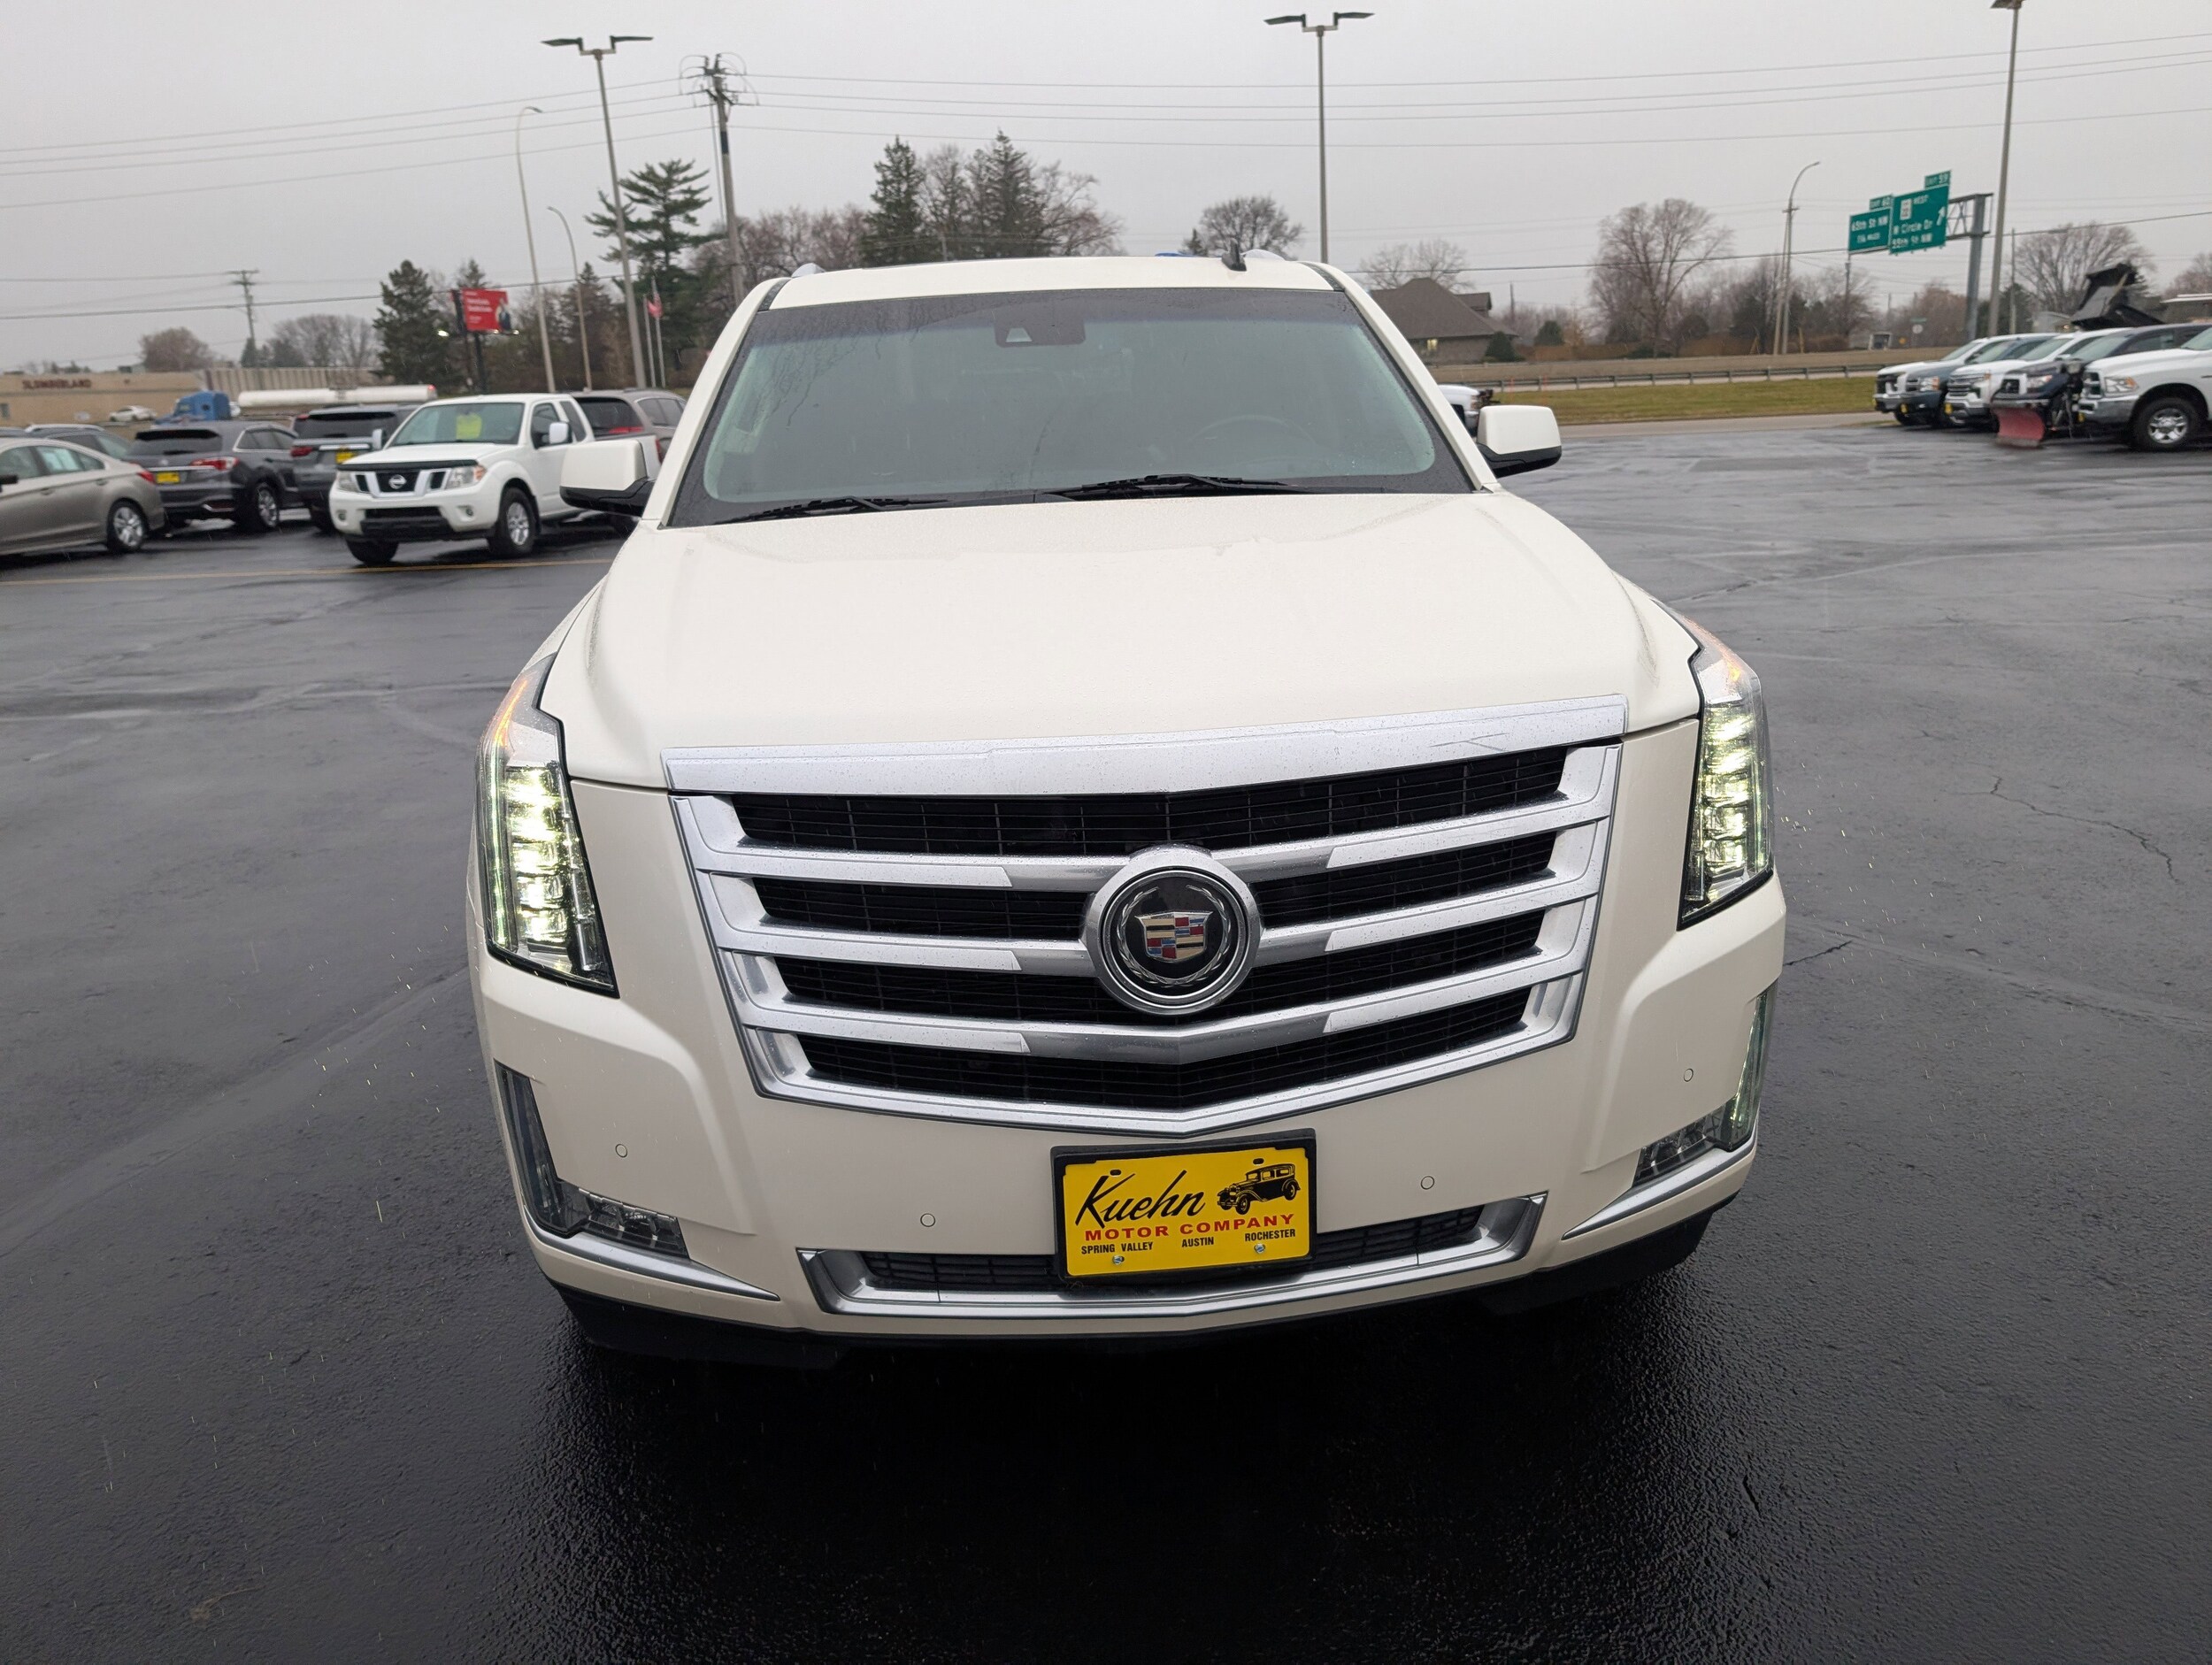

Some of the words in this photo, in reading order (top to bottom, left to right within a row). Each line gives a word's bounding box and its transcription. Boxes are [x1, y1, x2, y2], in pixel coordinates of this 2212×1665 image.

[1913, 195, 1929, 204] WEST
[1851, 220, 1867, 232] 65th
[1869, 218, 1877, 228] St
[1901, 222, 1923, 234] Circle
[1924, 219, 1933, 230] Dr
[1892, 238, 1909, 249] 55th
[1910, 235, 1919, 244] St
[1075, 1170, 1206, 1229] Kuehn
[1085, 1225, 1170, 1241] MOTOR
[1179, 1213, 1294, 1235] COMPANY
[1181, 1236, 1215, 1247] AUSTIN
[1244, 1228, 1296, 1242] ROCHESTER
[1081, 1244, 1116, 1255] SPRING
[1121, 1241, 1154, 1253] VALLEY
